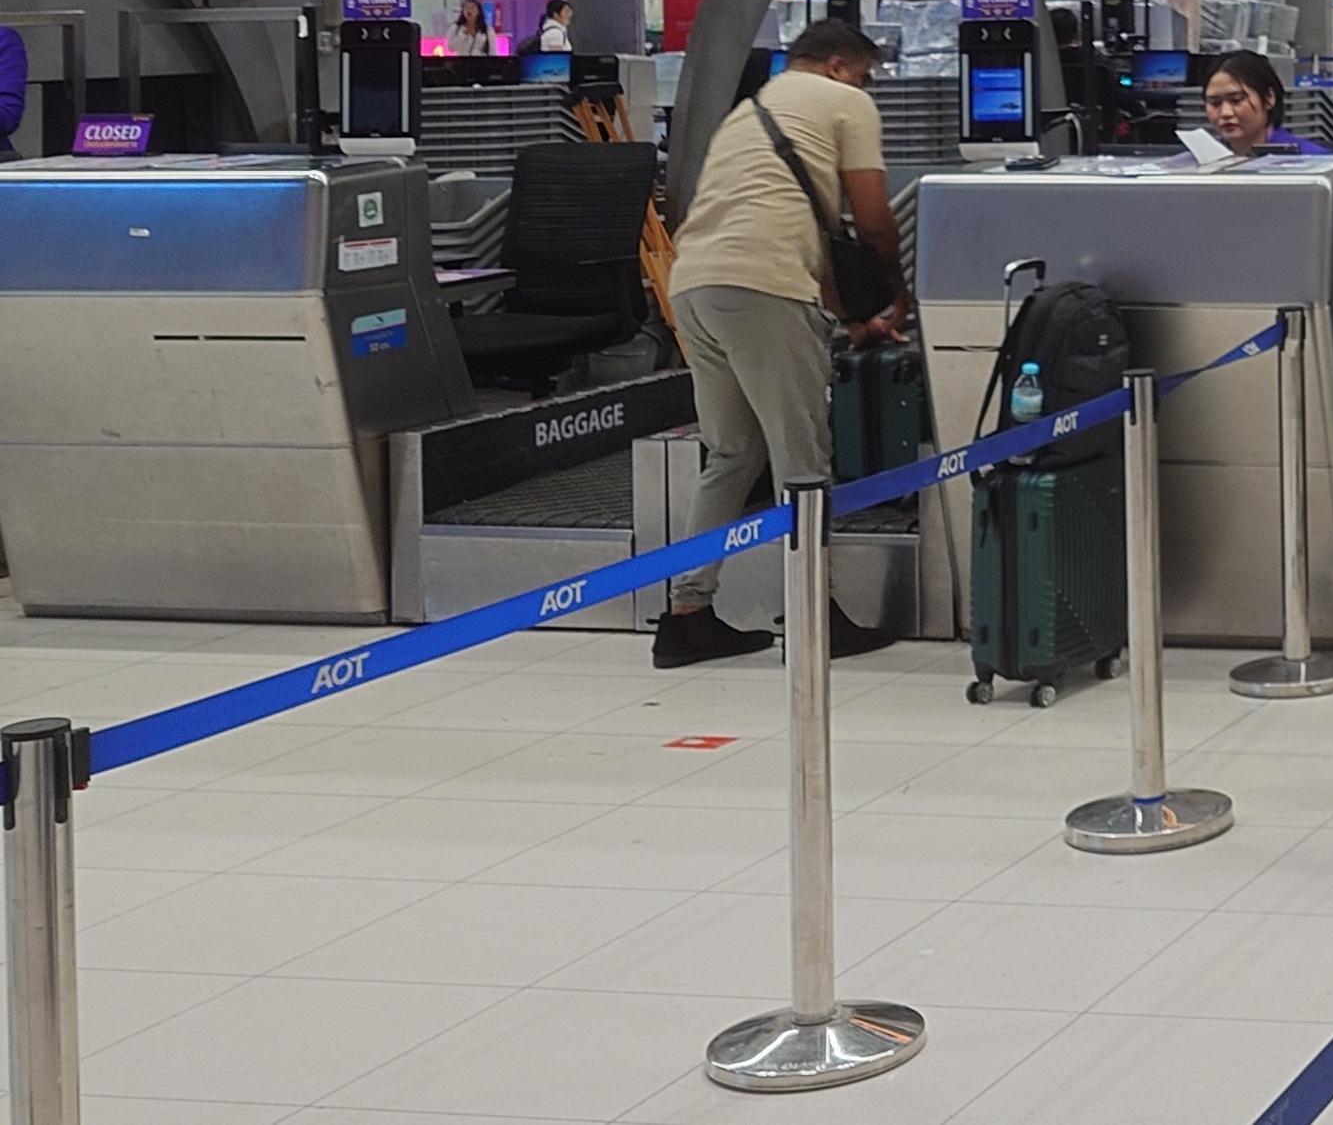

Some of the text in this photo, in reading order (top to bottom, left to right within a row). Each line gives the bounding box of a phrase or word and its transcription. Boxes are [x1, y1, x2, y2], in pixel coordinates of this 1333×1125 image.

[84, 125, 142, 141] CLOSED
[535, 403, 624, 447] BAGGAGE
[1053, 410, 1078, 437] AOT
[937, 450, 968, 478] AOT
[723, 517, 763, 551] AOT
[540, 579, 587, 616] AOT
[311, 651, 370, 693] AOT
